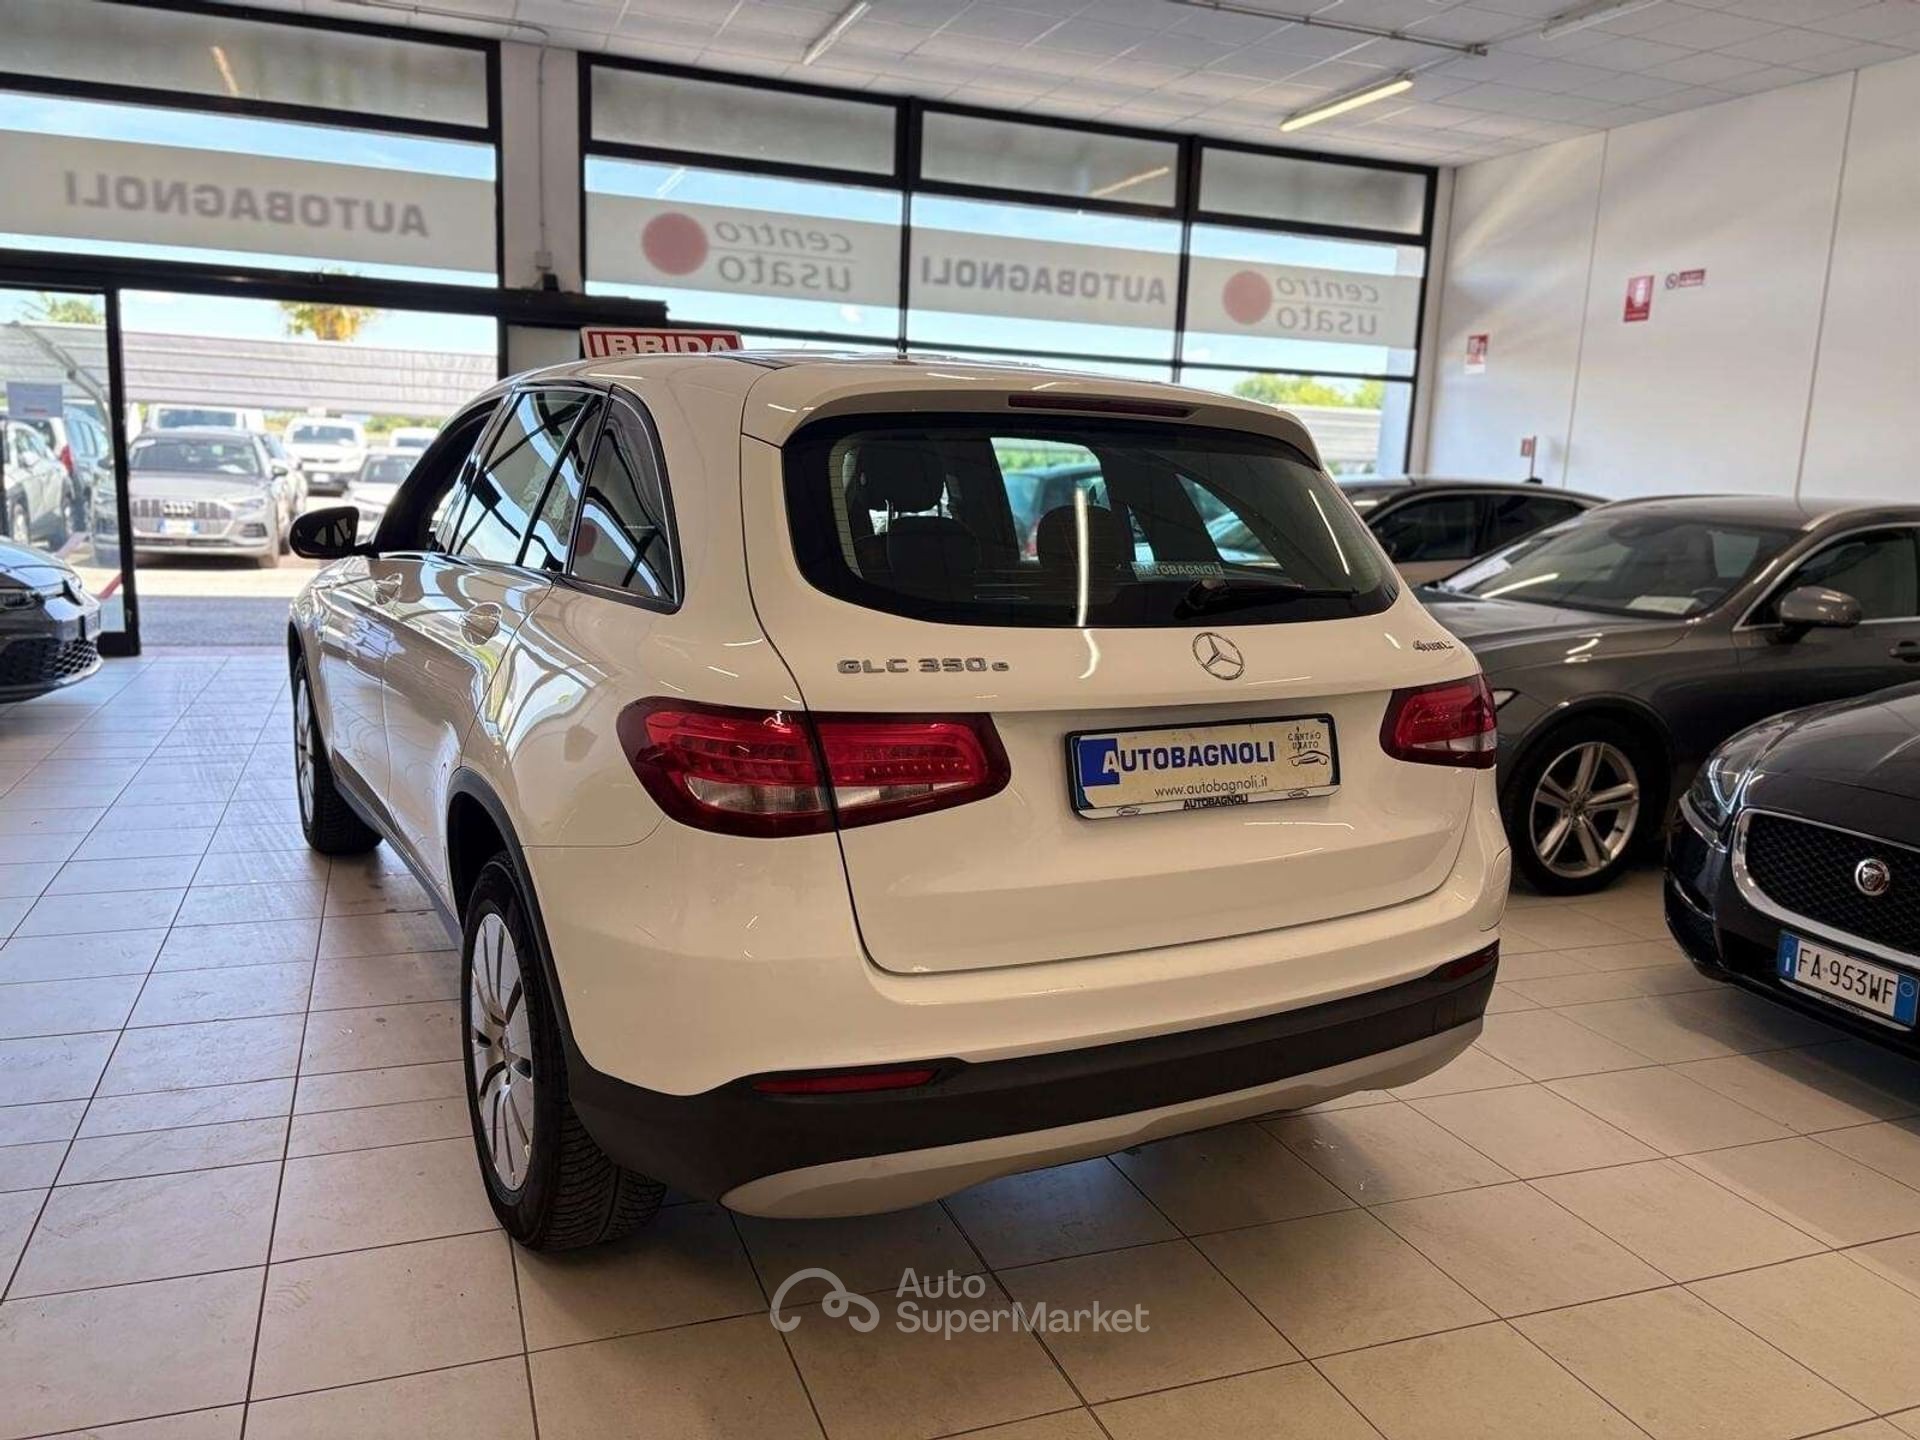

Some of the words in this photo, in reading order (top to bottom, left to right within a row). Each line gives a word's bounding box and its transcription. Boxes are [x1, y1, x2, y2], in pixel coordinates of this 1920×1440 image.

[591, 334, 733, 357] IBRIDA
[837, 659, 909, 674] GLC
[918, 657, 988, 673] 350
[991, 661, 1010, 672] e
[1102, 741, 1276, 774] AUTOBAGNOLI
[1154, 775, 1268, 797] www.autobagnoli.it
[1183, 793, 1249, 810] AUTOBAGNOLI
